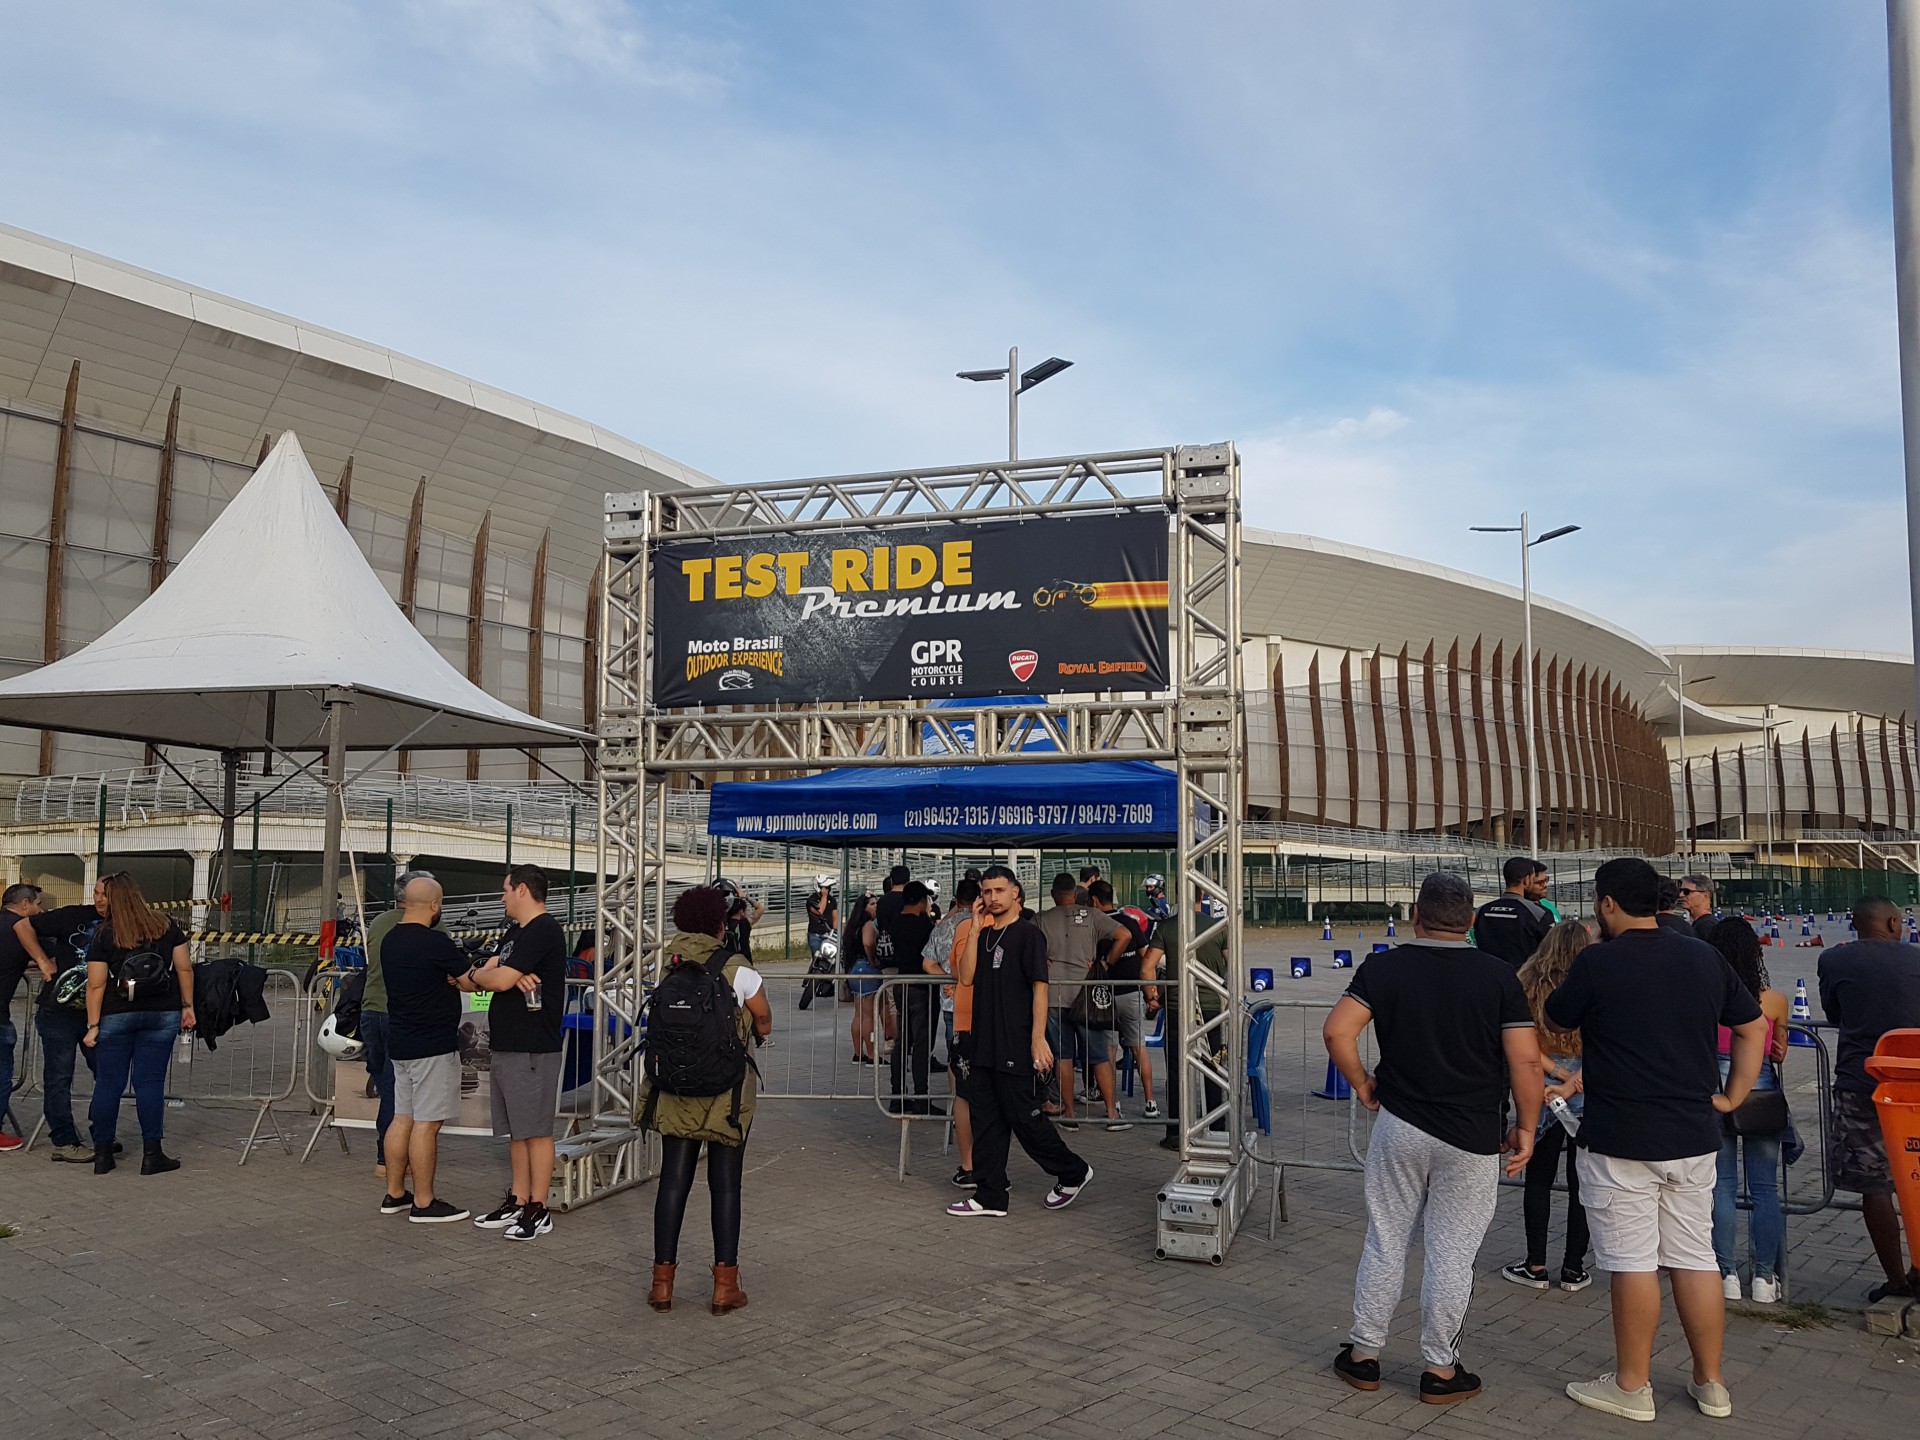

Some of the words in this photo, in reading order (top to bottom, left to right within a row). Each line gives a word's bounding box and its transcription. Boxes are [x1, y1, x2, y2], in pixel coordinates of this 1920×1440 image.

[682, 551, 809, 602] TEST
[832, 540, 972, 592] RIDE
[798, 581, 1022, 620] Premium
[688, 640, 730, 654] Moto
[733, 635, 779, 651] Brasil
[911, 639, 963, 665] GPR
[686, 653, 729, 681] OUTDOOR
[732, 651, 783, 677] EXPERIENCE
[911, 664, 963, 675] MOTORCYCLE
[1058, 662, 1097, 674] ROYAL
[1098, 661, 1147, 674] ENFIELD
[911, 676, 963, 687] COURSE
[736, 811, 878, 833] www.gprmotorcycle.com
[999, 805, 1068, 825] 96916-9797
[1079, 804, 1153, 825] 98479-7609
